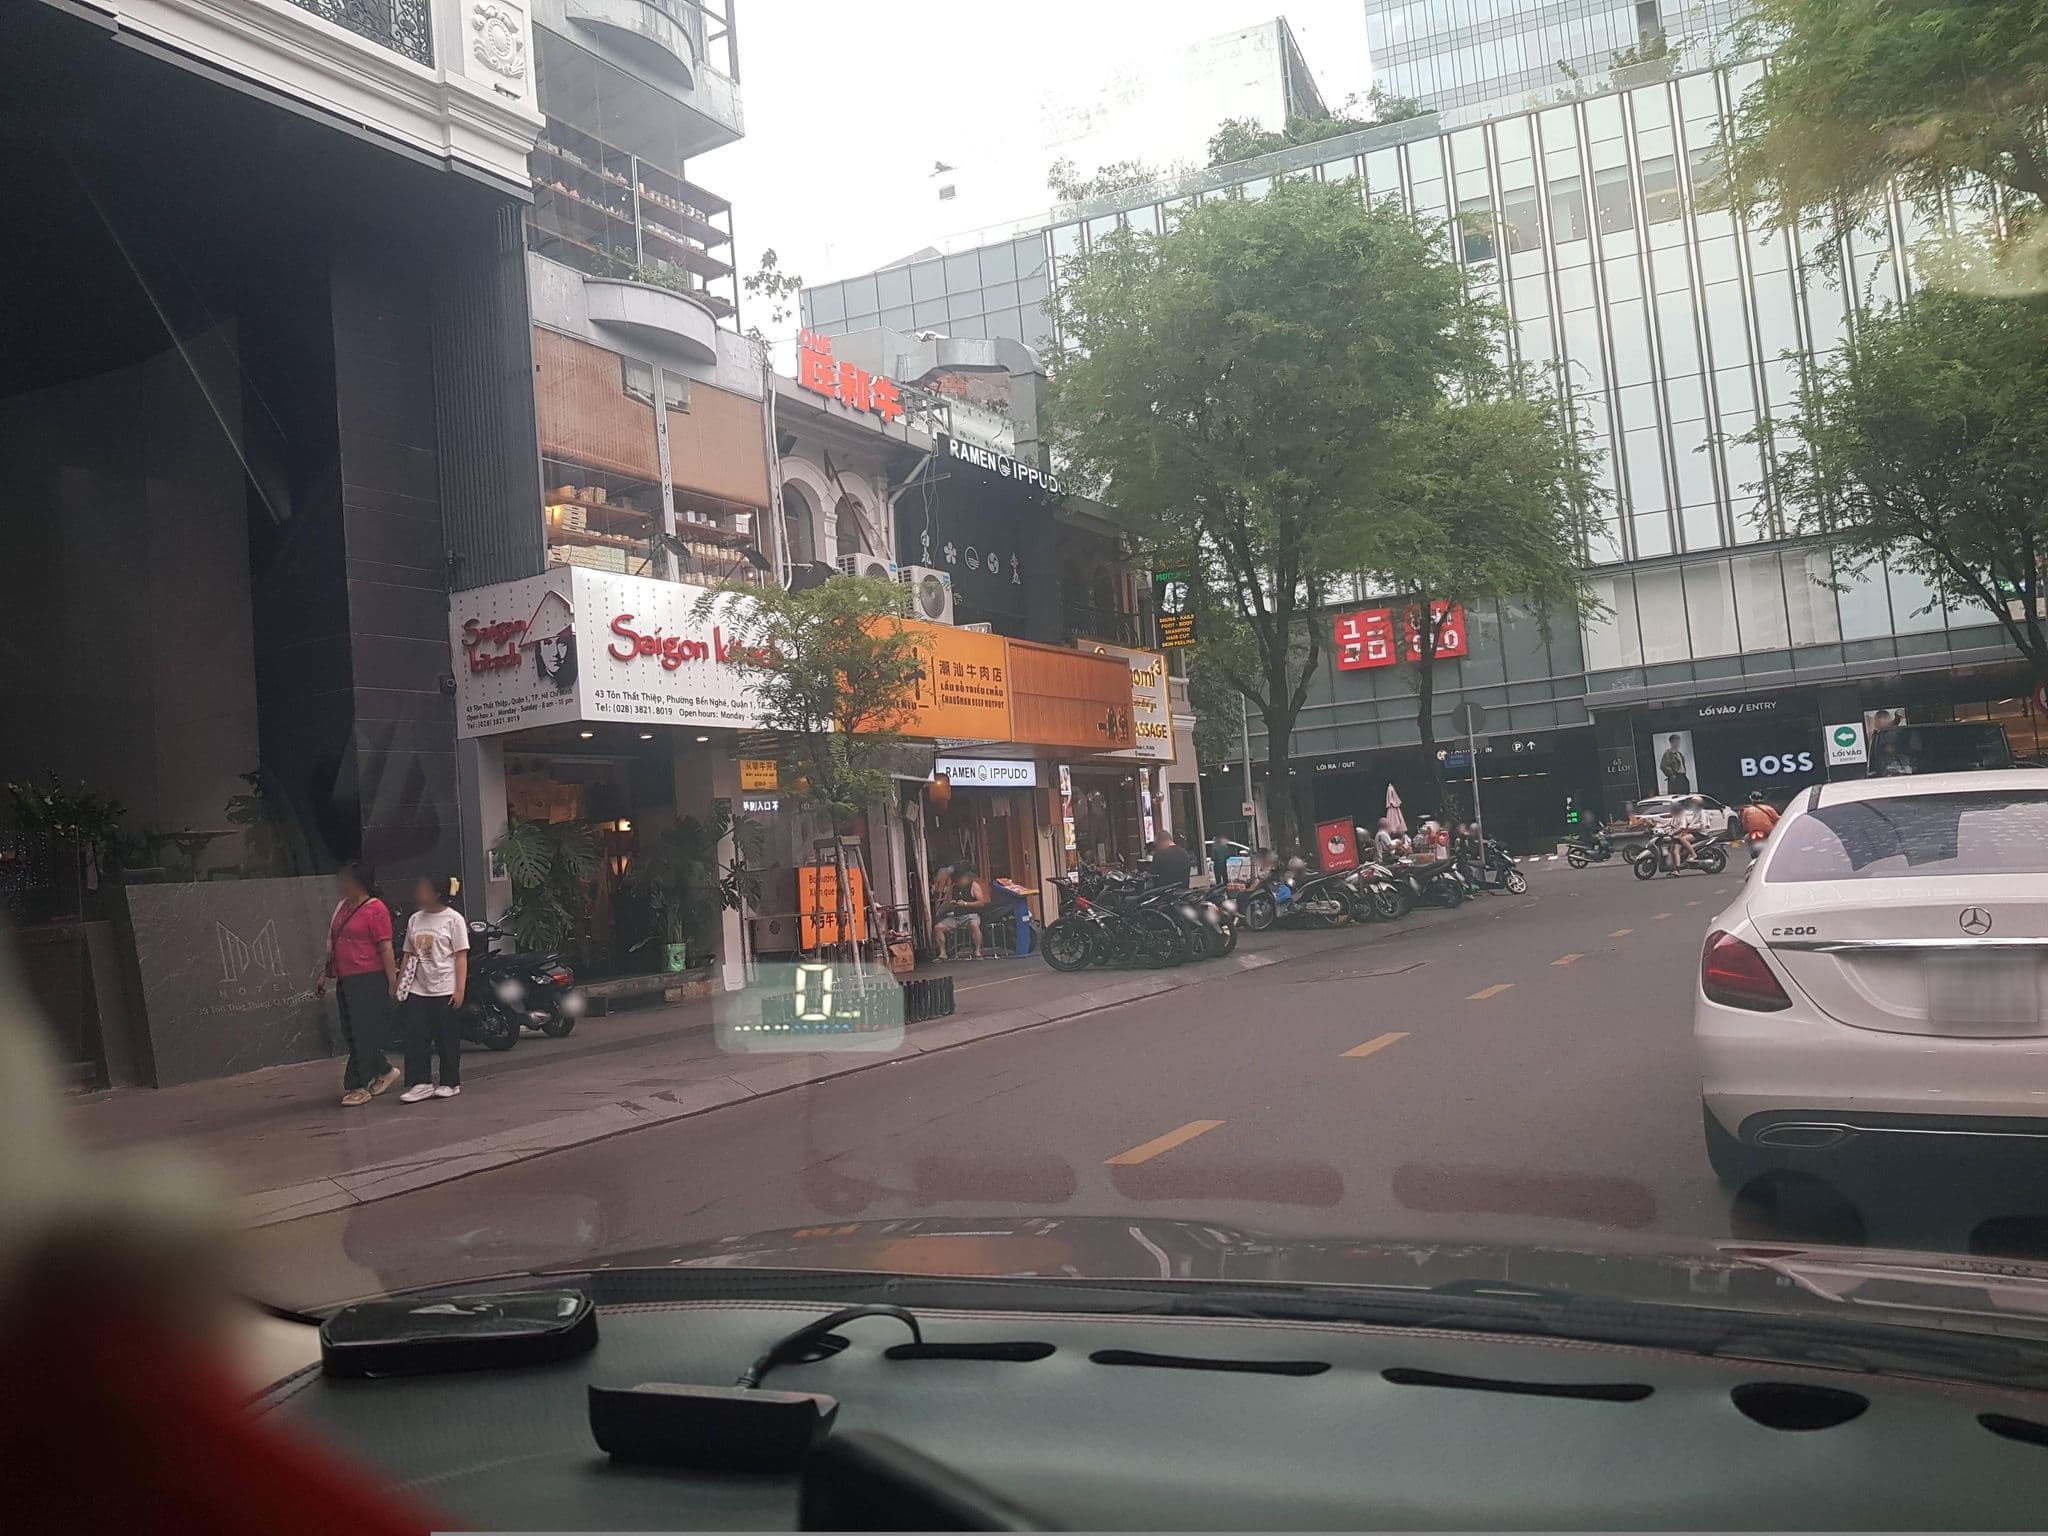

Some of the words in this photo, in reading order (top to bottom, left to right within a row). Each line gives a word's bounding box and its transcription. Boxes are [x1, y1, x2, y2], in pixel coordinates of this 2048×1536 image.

[949, 439, 997, 472] RAMEN
[1164, 627, 1191, 635] SHAMPOO
[594, 689, 605, 699] 43
[606, 690, 621, 699] Tôn
[622, 691, 639, 701] Thất
[640, 692, 665, 705] Thiệp,
[666, 694, 694, 707] Phường
[695, 696, 709, 705] Bến
[731, 700, 749, 709] Quận
[1746, 701, 1777, 712] ENTRY
[520, 703, 538, 713] Sunday
[595, 702, 611, 712] Tel:
[612, 703, 633, 715] (028)
[679, 708, 698, 718] Open
[698, 709, 719, 719] hours:
[720, 710, 746, 722] Monday
[1342, 761, 1356, 769] OUT
[1740, 751, 1814, 777] BOSS
[945, 766, 976, 779] RAMEN
[990, 767, 1028, 779] IPPUDO
[794, 963, 833, 1021] 0
